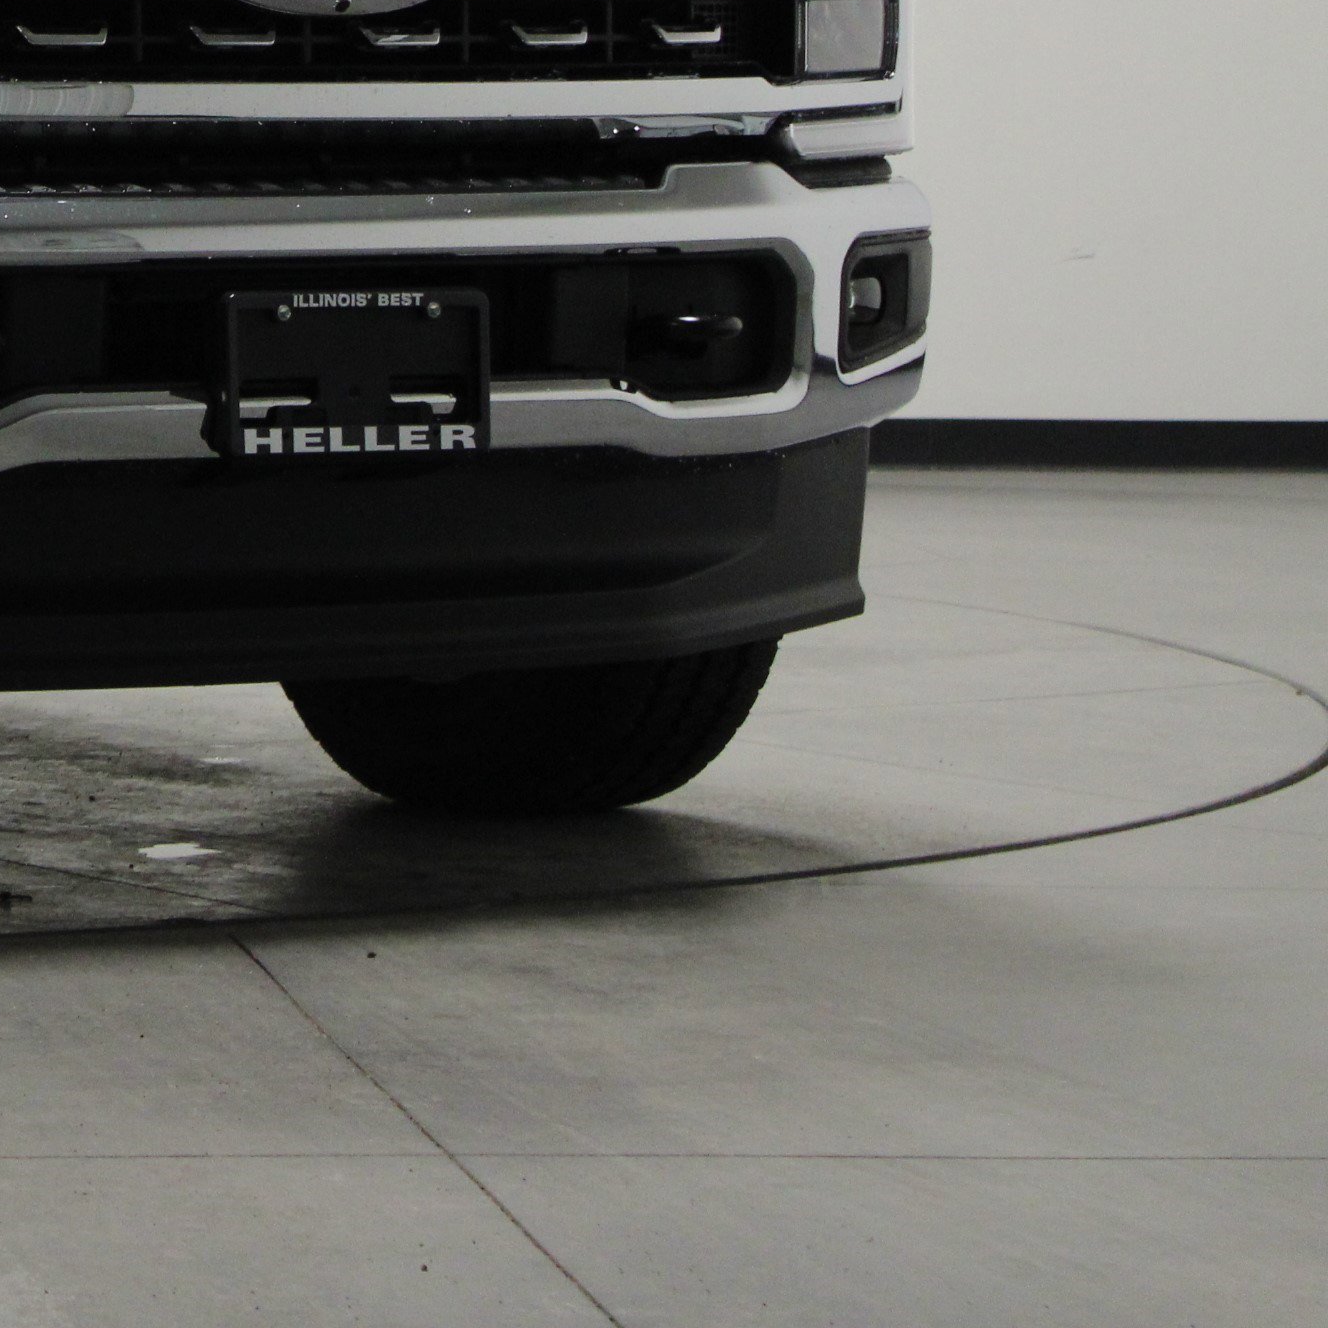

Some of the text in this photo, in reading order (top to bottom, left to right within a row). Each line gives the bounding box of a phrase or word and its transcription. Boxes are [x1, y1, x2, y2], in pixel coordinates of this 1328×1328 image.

[292, 292, 425, 308] ILLINOIS' BEST
[244, 424, 476, 454] HELLER
